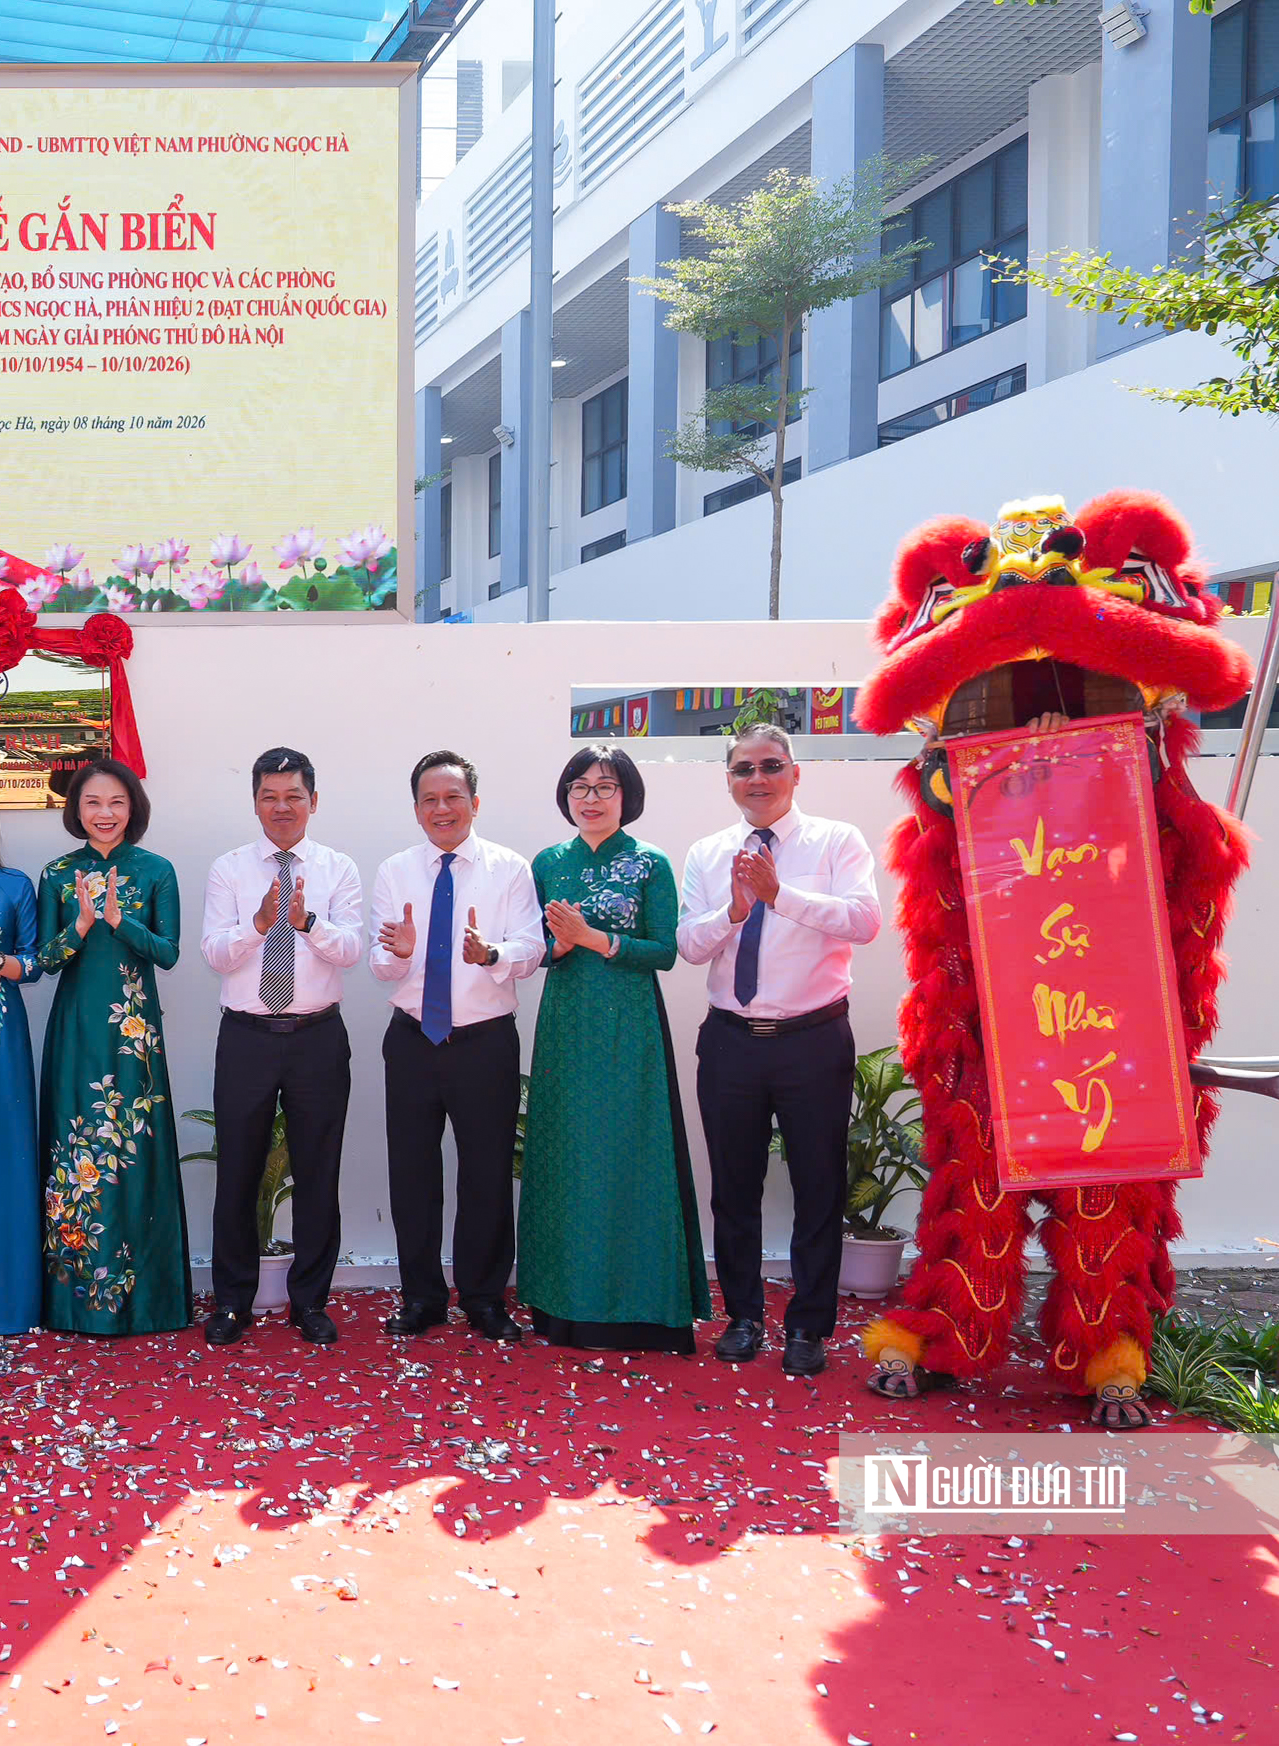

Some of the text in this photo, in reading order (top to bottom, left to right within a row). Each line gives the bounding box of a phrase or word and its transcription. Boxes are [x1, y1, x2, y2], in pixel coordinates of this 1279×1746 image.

[37, 137, 110, 156] UBMTTQ
[113, 133, 152, 157] VIỆT
[155, 136, 193, 153] NAM
[197, 132, 270, 153] PHƯỜNG
[273, 136, 322, 156] NGỌC
[326, 132, 350, 152] HÀ
[18, 195, 110, 252] GẮN
[119, 193, 217, 251] BIỂN
[31, 264, 56, 290] BỔ
[58, 272, 104, 290] SUNG
[108, 268, 168, 290] PHÒNG
[172, 271, 209, 292] HỌC
[211, 268, 235, 289] VÀ
[238, 268, 273, 289] CÁC
[276, 267, 336, 288] PHÒNG
[24, 301, 71, 321] NGỌC
[74, 297, 102, 320] HÀ,
[105, 296, 150, 318] PHÂN
[153, 296, 193, 319] HIỆU
[195, 300, 205, 317] 2
[208, 299, 244, 319] (ĐẠT
[246, 293, 303, 317] CHUẨN
[305, 293, 351, 319] QUỐC
[353, 299, 387, 317] GIA)
[13, 324, 61, 346] NGÀY
[63, 323, 99, 346] GIẢI
[103, 325, 162, 345] PHÓNG
[164, 323, 198, 345] THỦ
[202, 324, 225, 345] ĐÔ
[228, 324, 253, 345] HÀ
[255, 324, 285, 348] NỘI
[101, 356, 191, 375] 10/10/2026)
[14, 415, 37, 433] Hà,
[40, 417, 70, 434] ngày
[73, 416, 88, 430] 08
[91, 416, 126, 433] tháng
[129, 416, 144, 430] 10
[146, 416, 173, 429] năm
[176, 415, 206, 429] 2026
[1009, 815, 1099, 878] Vạn
[1034, 902, 1091, 965] Sự
[1032, 982, 1116, 1044] Như
[1052, 1050, 1118, 1153] Ý
